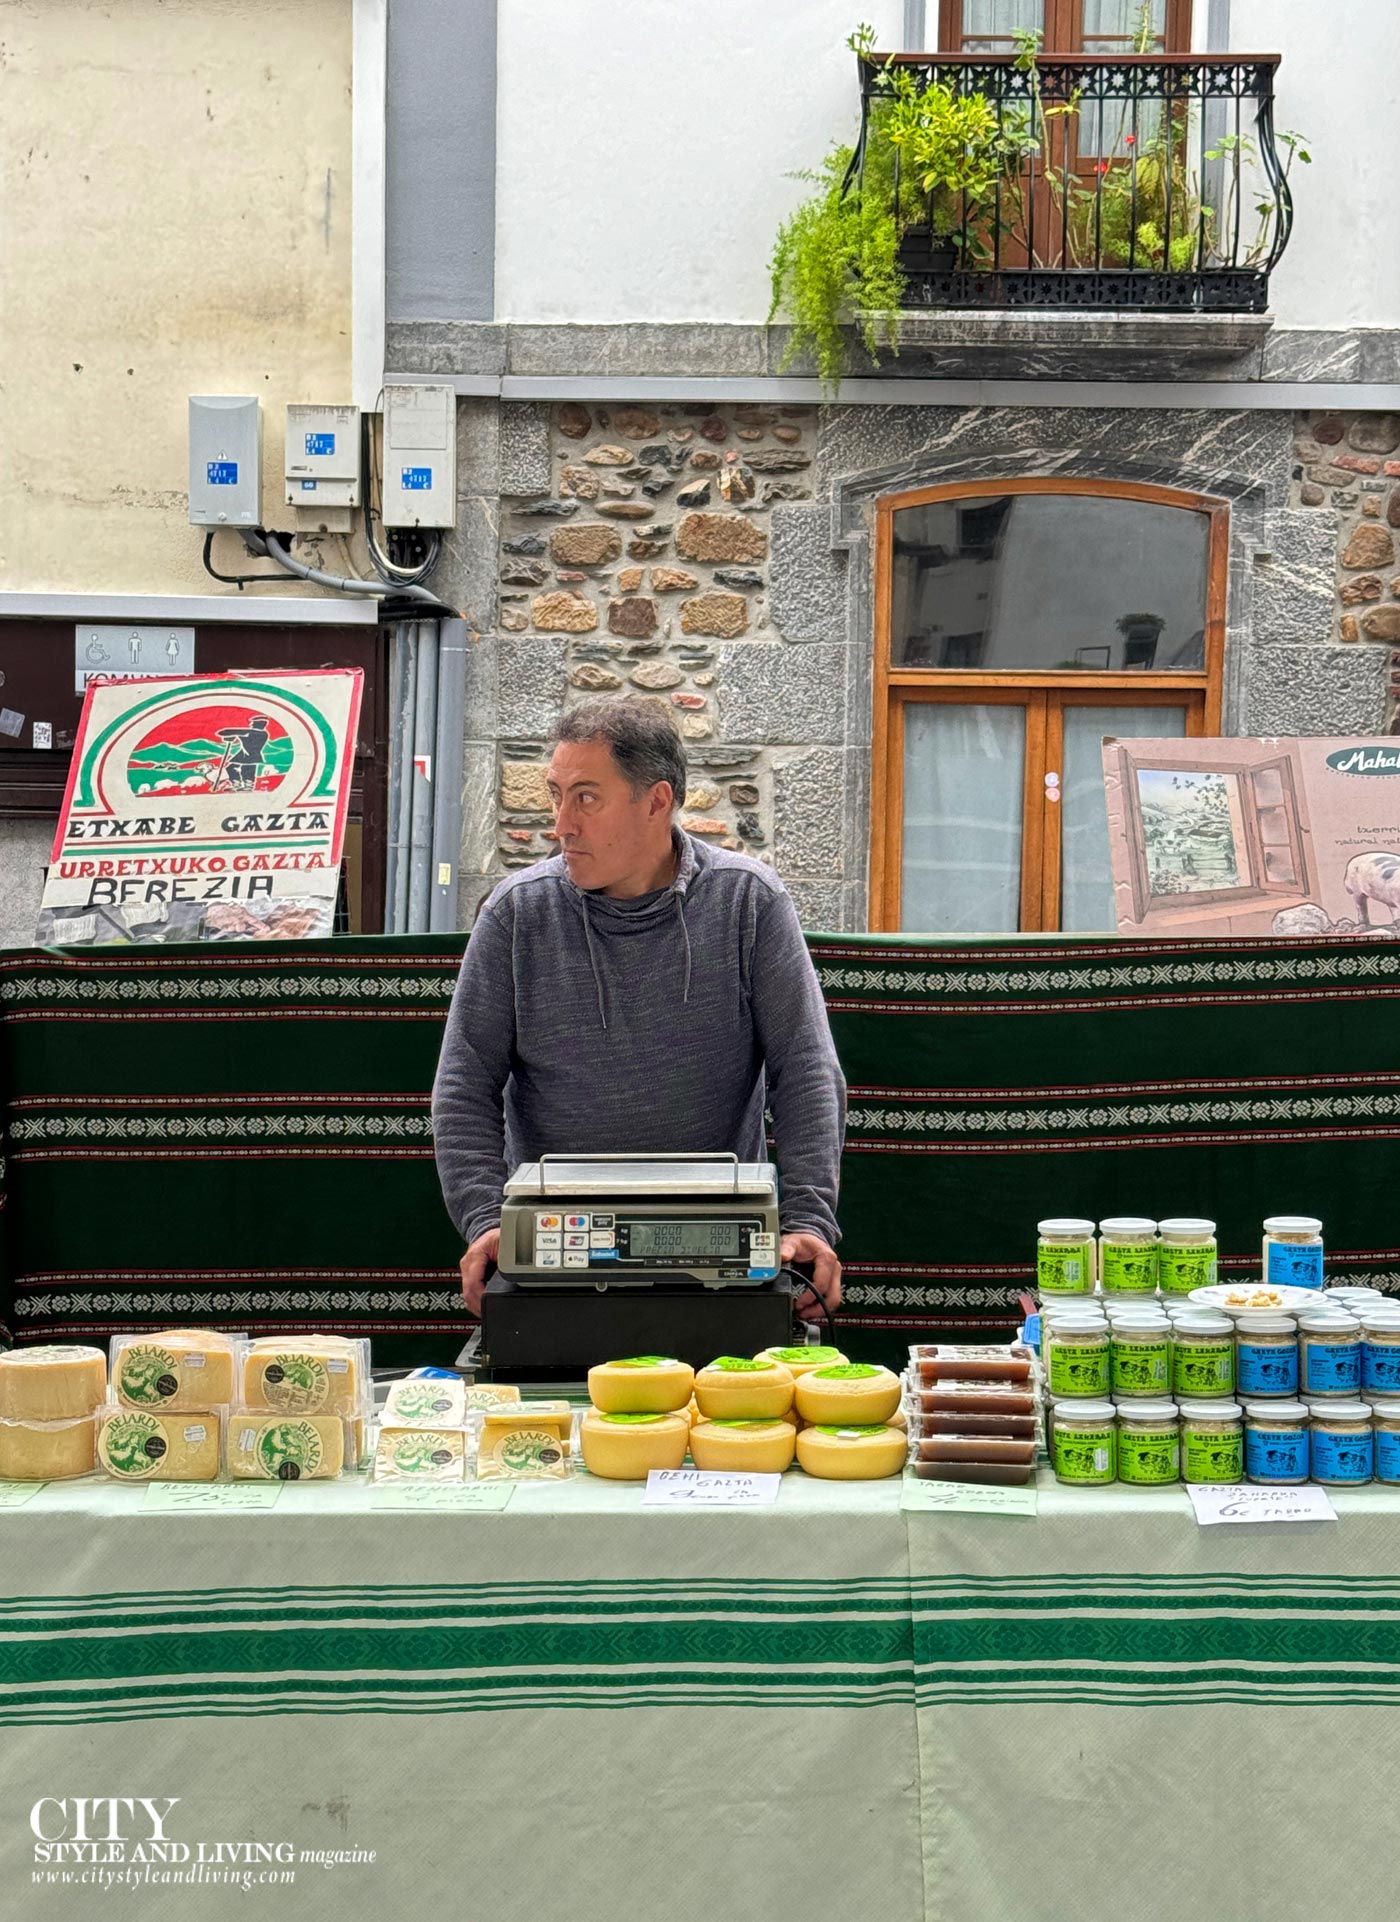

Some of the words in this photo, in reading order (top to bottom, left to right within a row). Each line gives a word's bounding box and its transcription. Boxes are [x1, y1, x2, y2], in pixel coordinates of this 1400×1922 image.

[67, 816, 196, 838] ETXABE
[221, 812, 329, 833] GAZTA
[60, 856, 226, 879] URRETXUKO
[233, 852, 325, 872] GAZTA
[128, 1345, 178, 1370] BEIARDI
[107, 1414, 160, 1433] BEIARDI
[298, 1421, 321, 1474] BEIARDI
